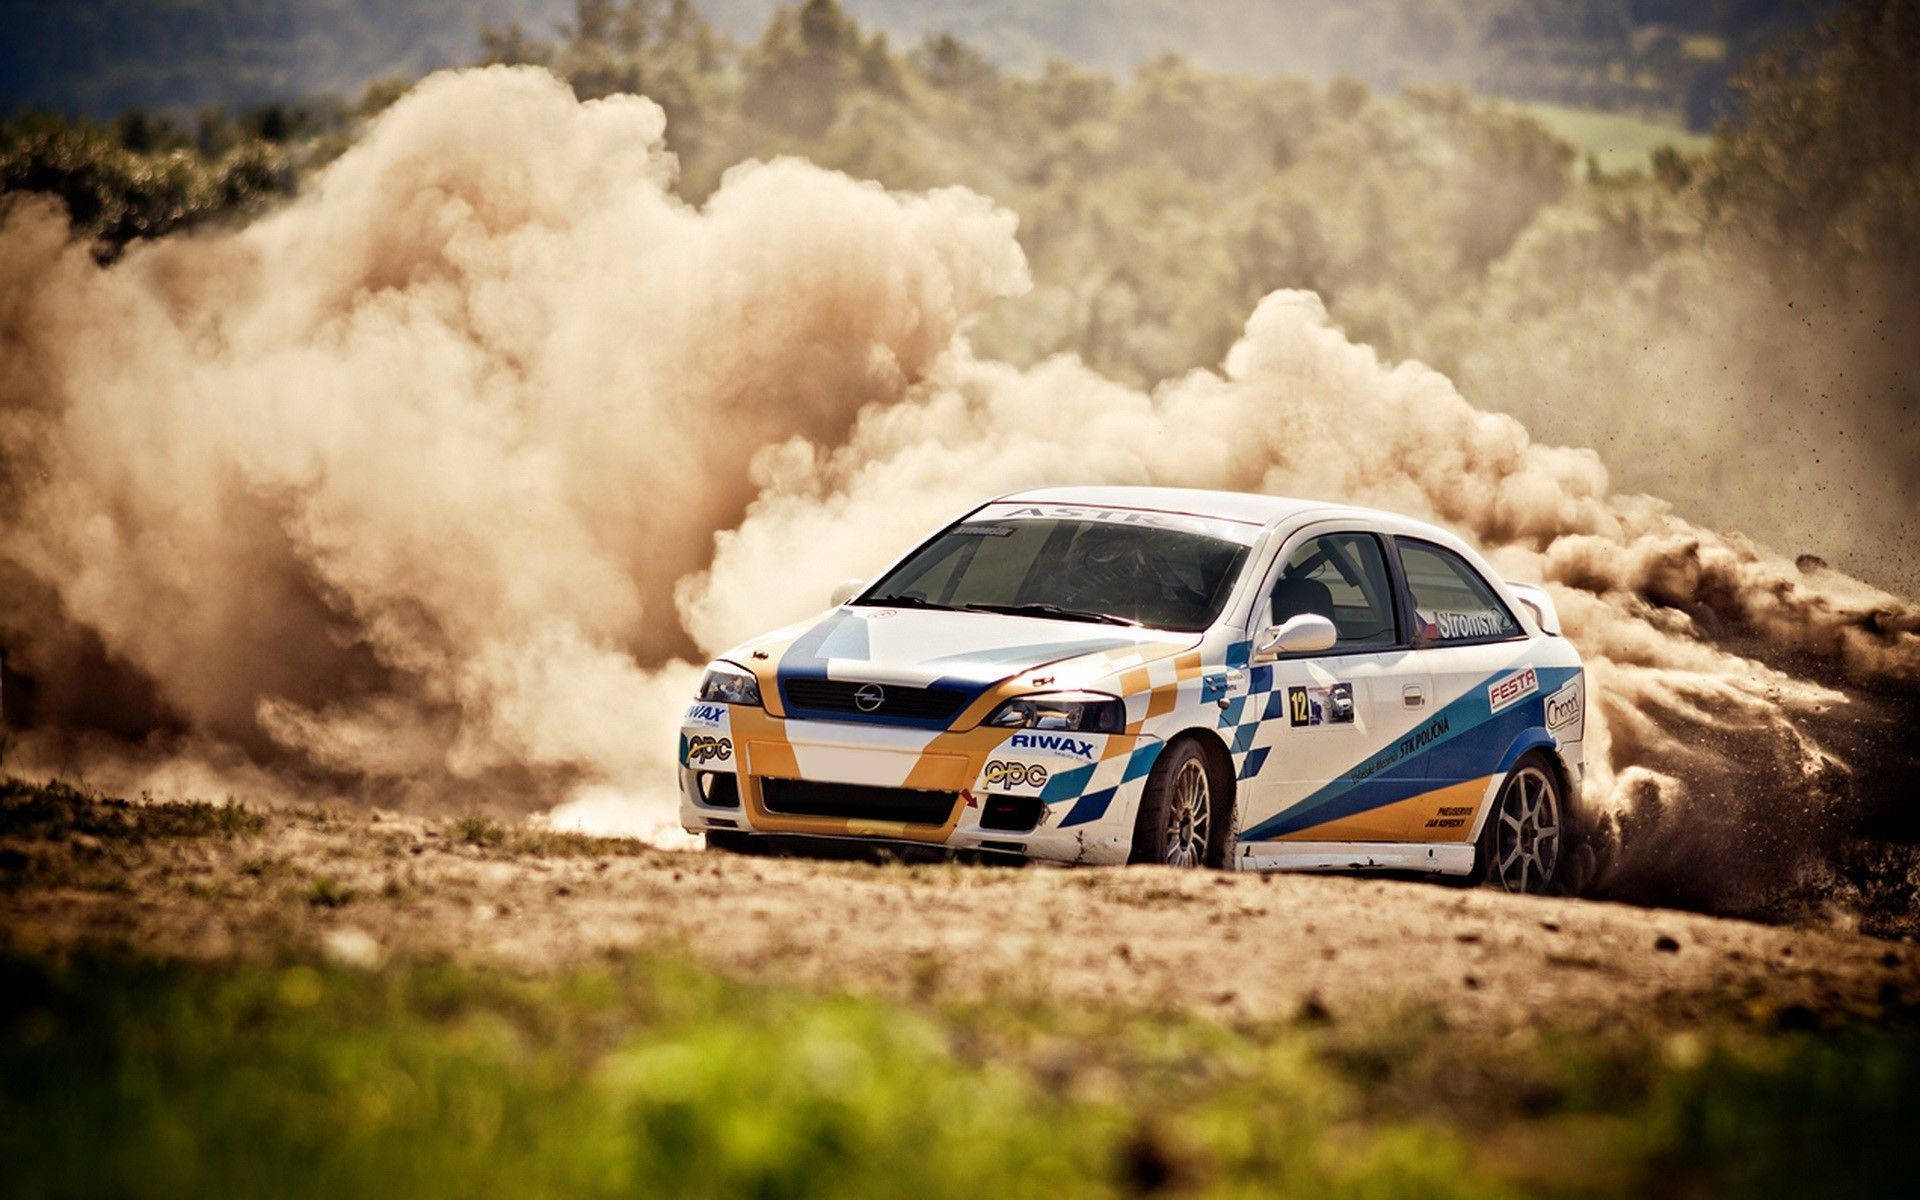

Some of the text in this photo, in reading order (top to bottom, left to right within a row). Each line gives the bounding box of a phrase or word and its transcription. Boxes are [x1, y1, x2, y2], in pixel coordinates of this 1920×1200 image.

[1490, 669, 1536, 704] FESTA
[1291, 690, 1308, 722] 12
[687, 735, 733, 764] opc
[1011, 735, 1094, 760] RIWAX
[983, 760, 1047, 791] opc
